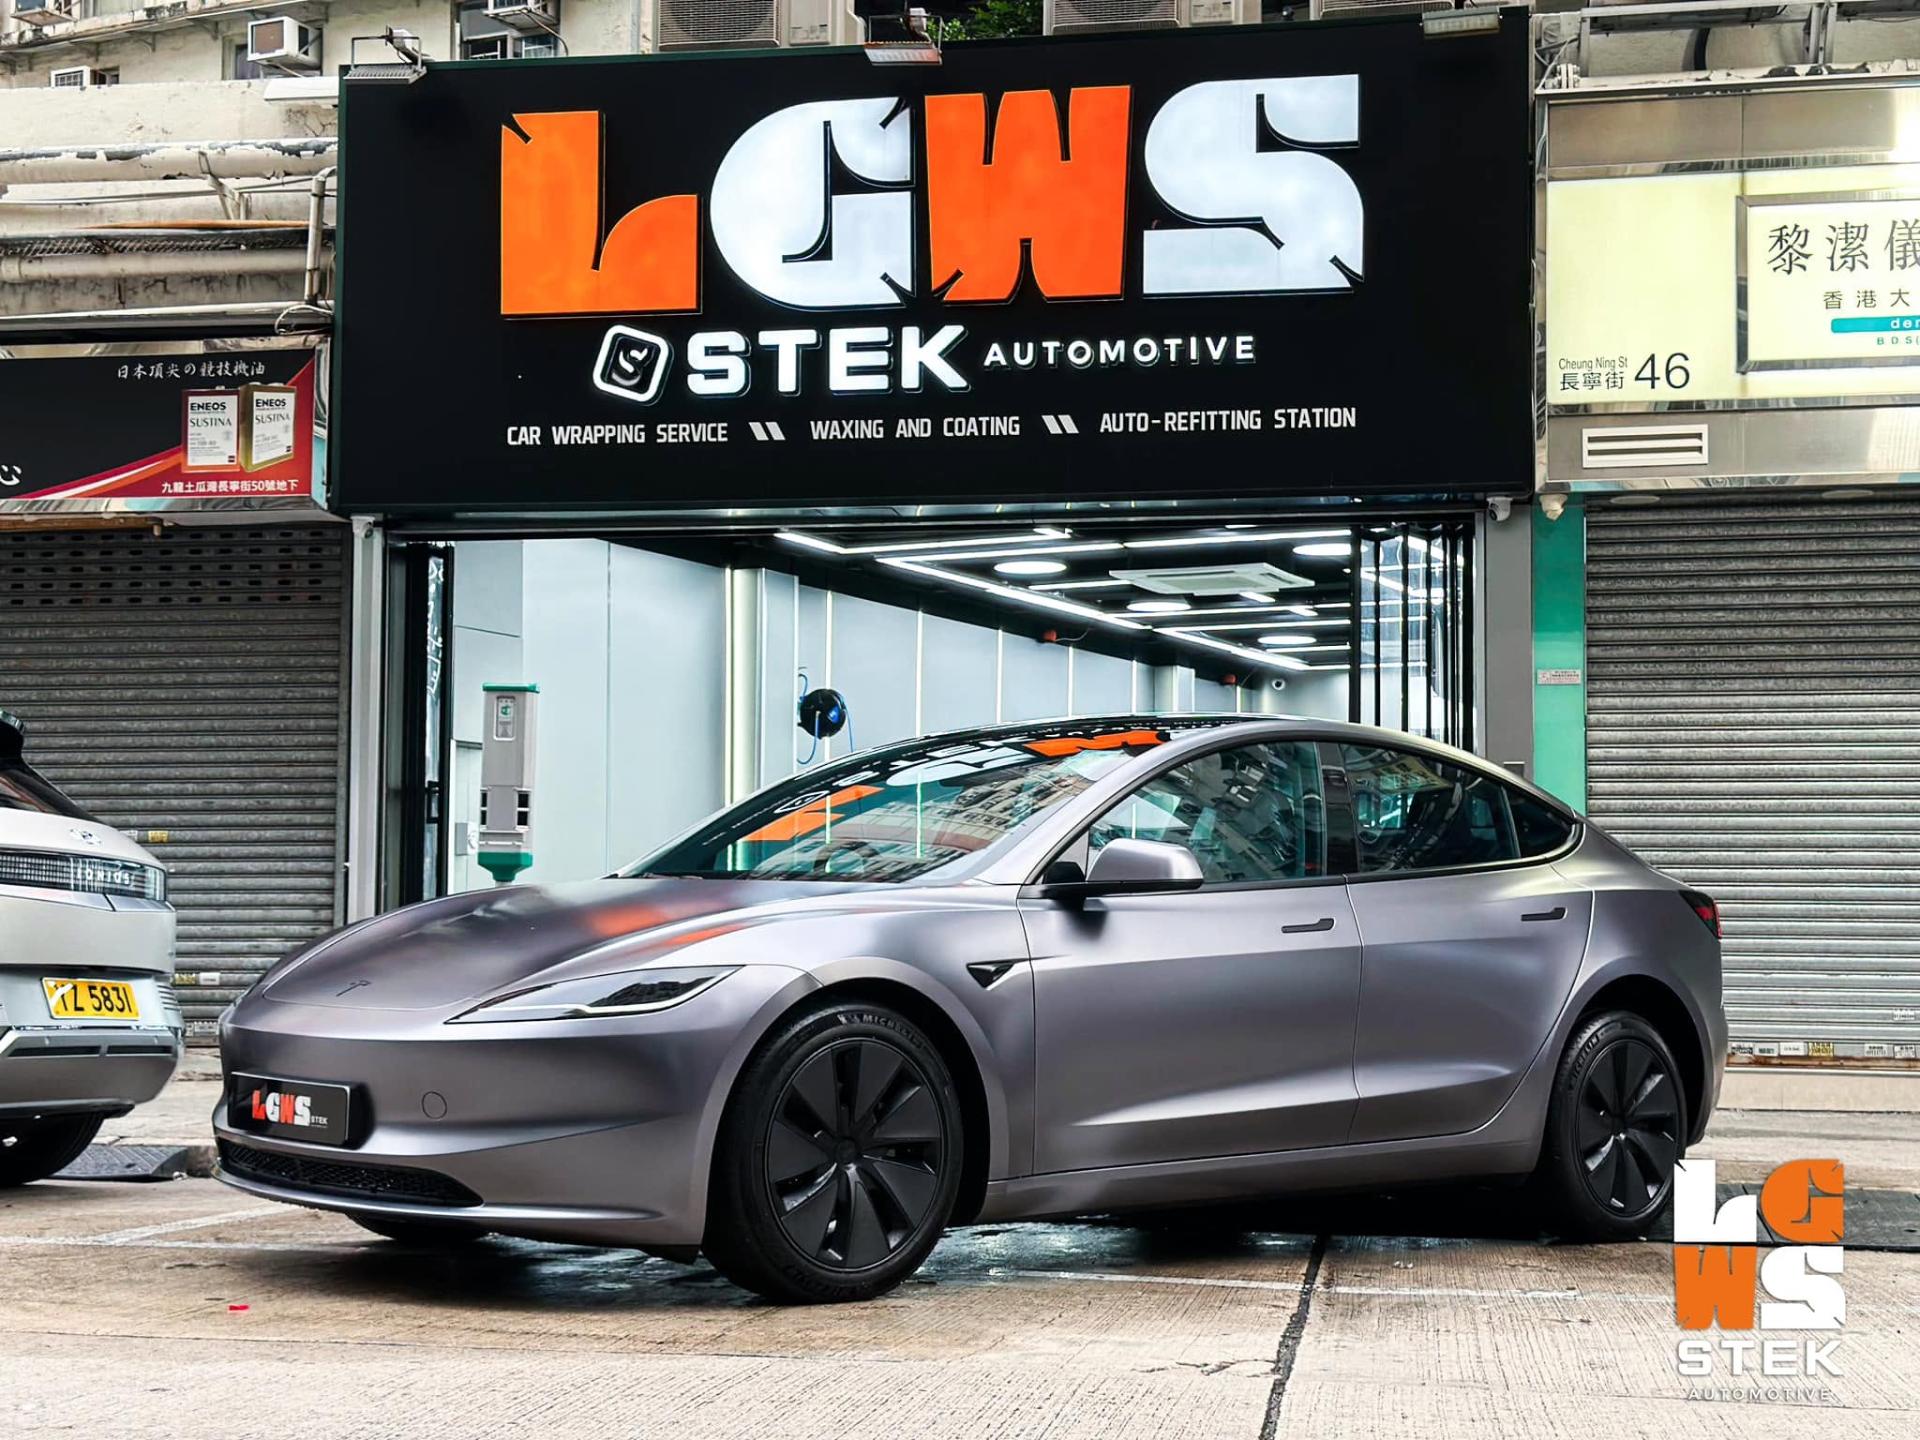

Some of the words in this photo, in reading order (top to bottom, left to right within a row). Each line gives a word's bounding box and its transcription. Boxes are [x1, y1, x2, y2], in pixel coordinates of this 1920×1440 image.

[501, 74, 1364, 318] LGWS
[1824, 288, 1910, 310] 香港大
[687, 325, 970, 397] STEK
[984, 335, 1256, 369] AUTOMOTIVE
[1559, 358, 1593, 371] Cheung
[1595, 356, 1616, 370] Ning
[1618, 355, 1628, 368] St
[1634, 352, 1690, 389] 46
[1560, 372, 1624, 390] 長寧街
[190, 402, 226, 411] ENEOS
[256, 399, 286, 407] ENEOS
[189, 418, 232, 428] SUSTINA
[255, 413, 290, 424] SUSTINA
[507, 426, 541, 446] CAR
[552, 424, 645, 445] WRAPPING
[656, 423, 728, 444] SERVICE
[810, 419, 884, 440] WAXING
[896, 418, 931, 438] AND
[943, 416, 1020, 437] COATING
[1100, 410, 1261, 433] AUTO-REFITTING
[1274, 408, 1356, 429] STATION
[88, 985, 132, 1013] 5831
[252, 1090, 311, 1126] LGWS
